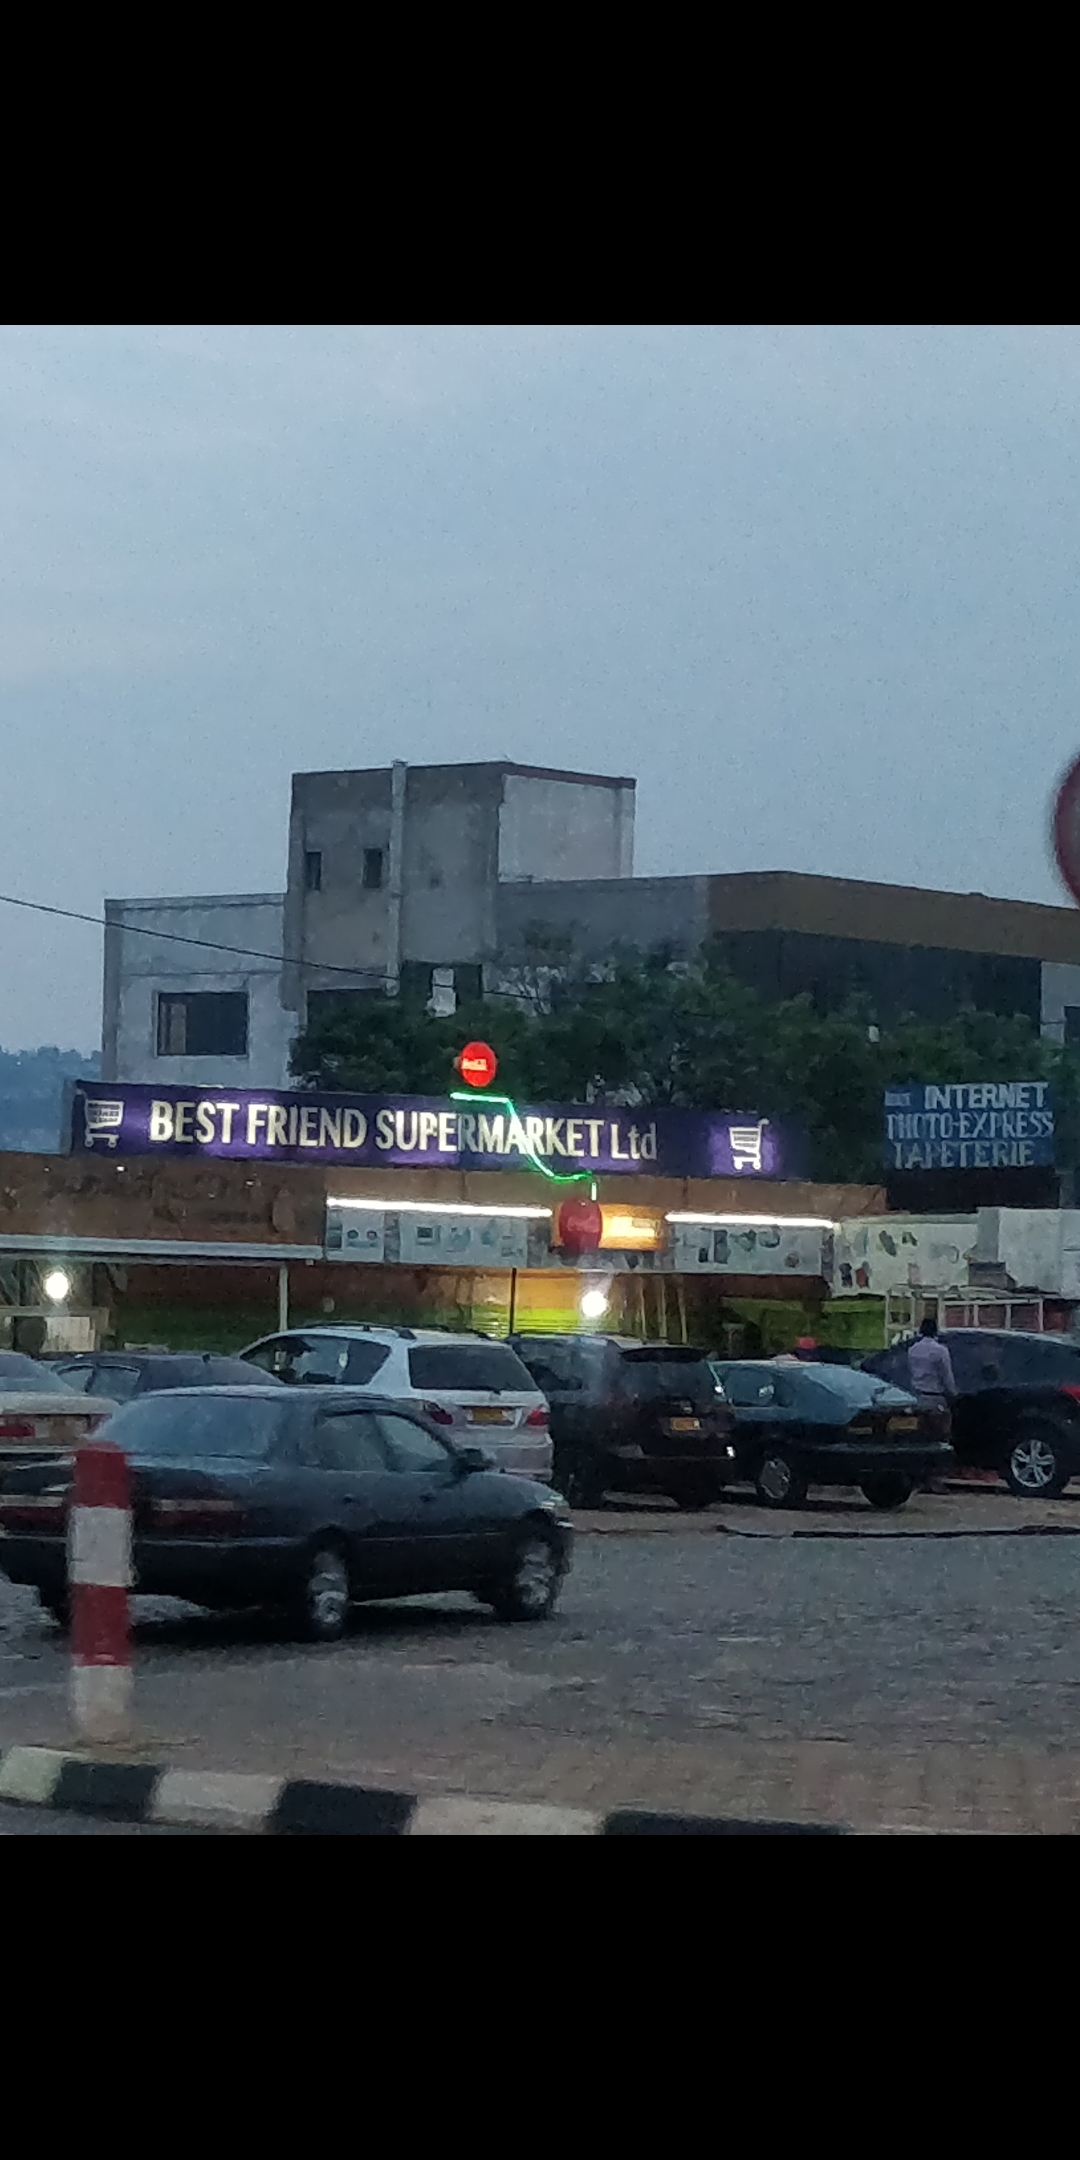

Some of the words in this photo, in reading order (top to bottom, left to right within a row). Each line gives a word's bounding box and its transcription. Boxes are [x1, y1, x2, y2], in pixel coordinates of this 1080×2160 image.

[924, 1082, 1050, 1110] INTERNET
[149, 1099, 240, 1144] BEST
[246, 1103, 367, 1149] FRIEND
[375, 1109, 604, 1158] SUPERMARKET
[611, 1123, 658, 1161] Ltd
